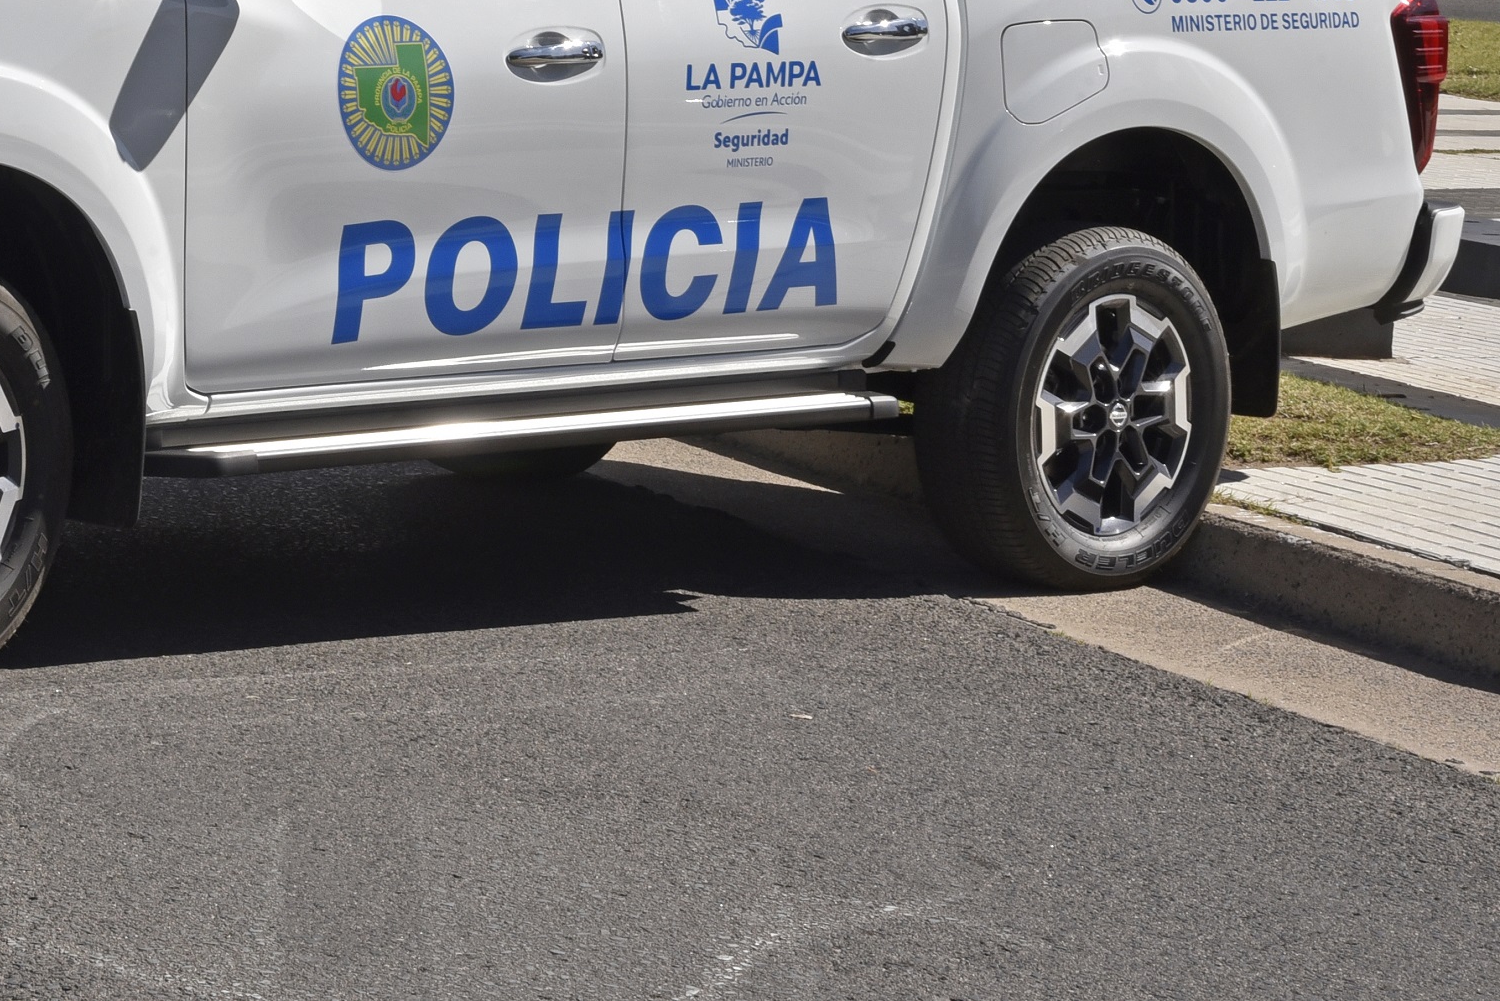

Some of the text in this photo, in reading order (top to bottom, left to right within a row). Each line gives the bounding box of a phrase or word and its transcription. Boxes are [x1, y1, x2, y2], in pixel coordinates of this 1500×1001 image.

[1171, 11, 1360, 33] MINISTERIO DE SEGURIDAD
[374, 69, 392, 106] PROVINCIA
[402, 69, 410, 77] LA
[410, 75, 422, 104] PAMPA
[686, 61, 822, 91] LA PAMPA
[702, 92, 807, 109] Gobierno en Acción
[714, 128, 789, 153] Seguridad
[726, 157, 774, 169] MINISTERIO
[331, 197, 838, 345] POLICIA
